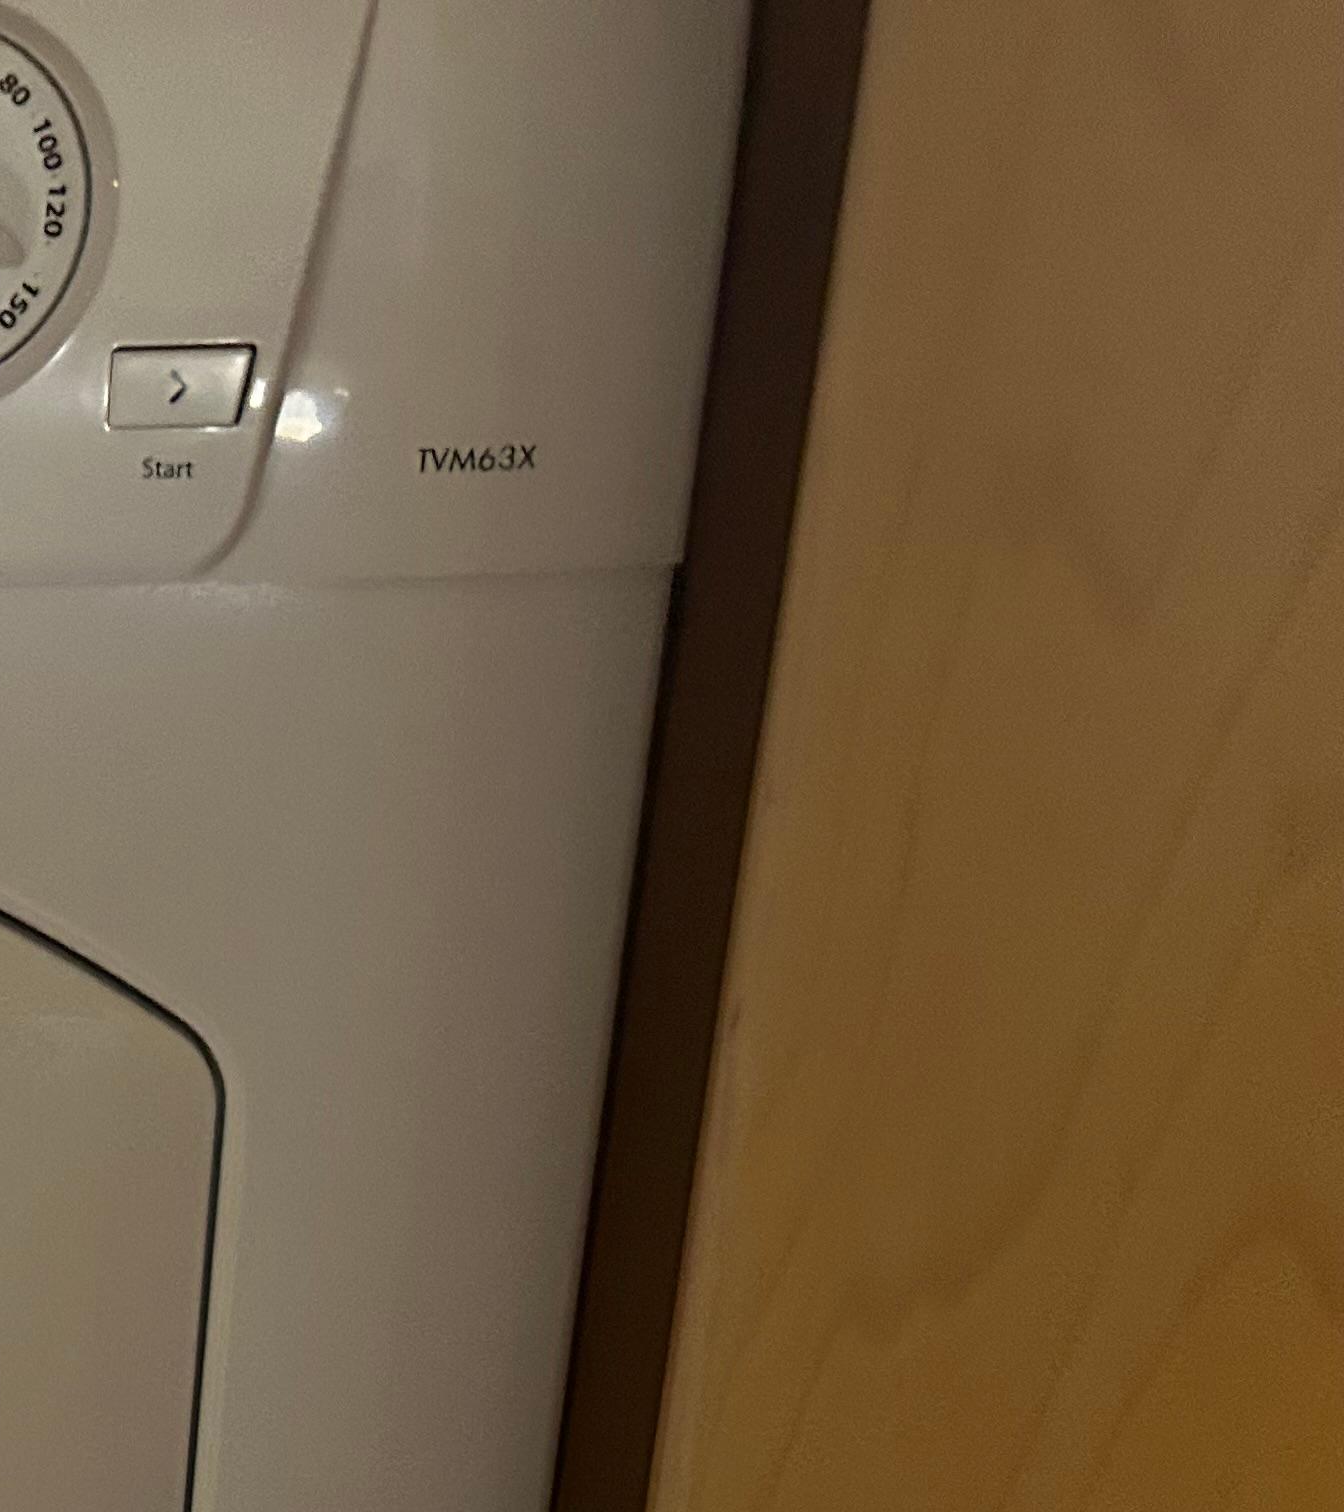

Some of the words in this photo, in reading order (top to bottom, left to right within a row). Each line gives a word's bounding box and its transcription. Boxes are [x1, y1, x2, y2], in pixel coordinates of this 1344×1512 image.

[32, 117, 63, 171] 100
[43, 184, 67, 239] 120
[141, 456, 194, 481] Start
[418, 444, 538, 475] TVM63X
